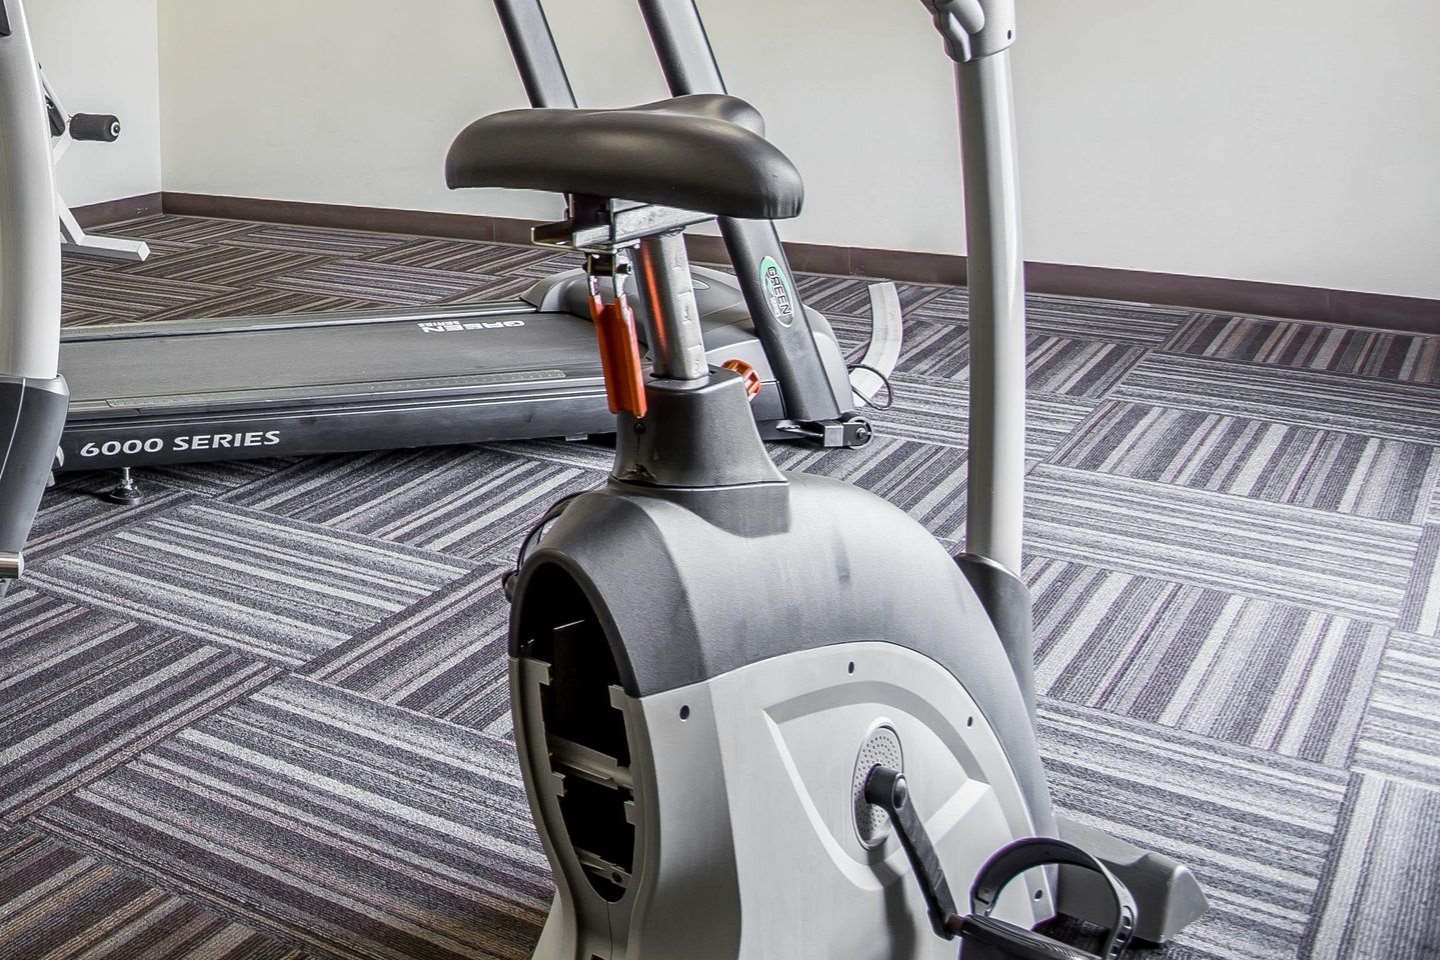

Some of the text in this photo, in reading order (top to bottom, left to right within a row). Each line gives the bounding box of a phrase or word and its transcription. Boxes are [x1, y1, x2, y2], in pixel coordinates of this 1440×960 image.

[766, 266, 792, 316] GREEN
[423, 320, 526, 334] GREEN
[79, 430, 281, 458] 6000 SERIES
